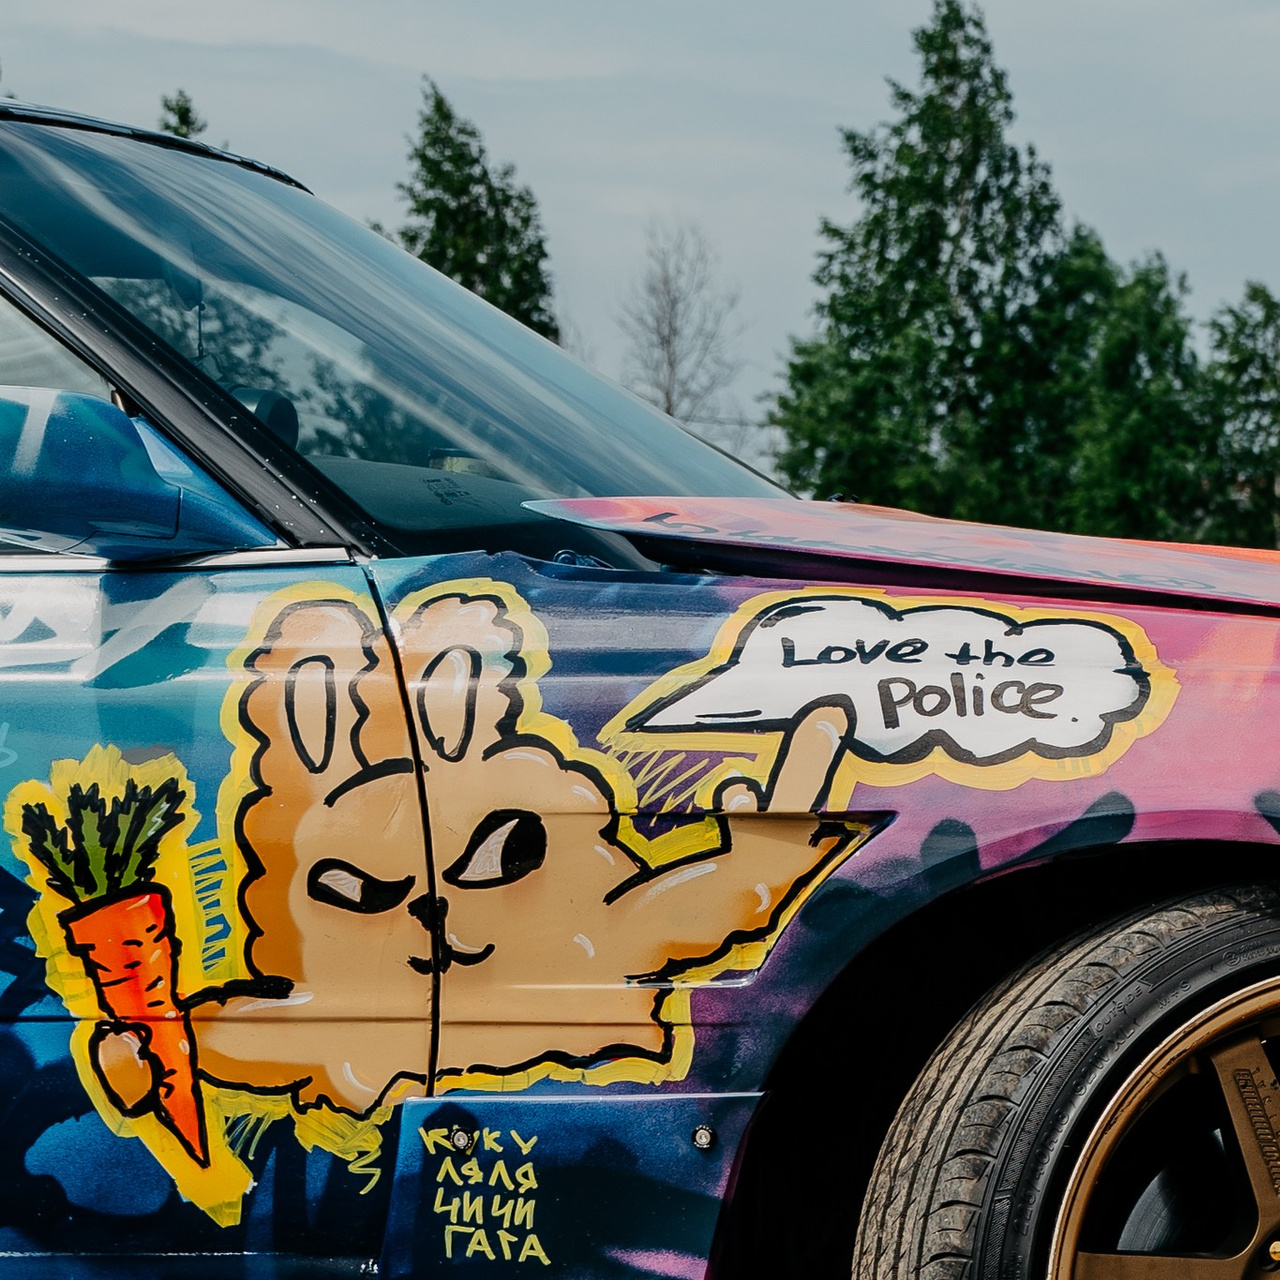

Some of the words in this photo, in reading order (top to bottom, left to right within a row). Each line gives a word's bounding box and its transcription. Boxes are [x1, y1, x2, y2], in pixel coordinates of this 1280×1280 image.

[781, 637, 929, 667] Love
[944, 639, 1056, 667] the
[1095, 985, 1143, 1034] OUTSIDE
[1155, 979, 1193, 1010] M+S
[436, 1156, 539, 1194] ЛЯЛЯ
[433, 1187, 536, 1230] ЧИЧИ
[444, 1224, 552, 1266] ГАГА
